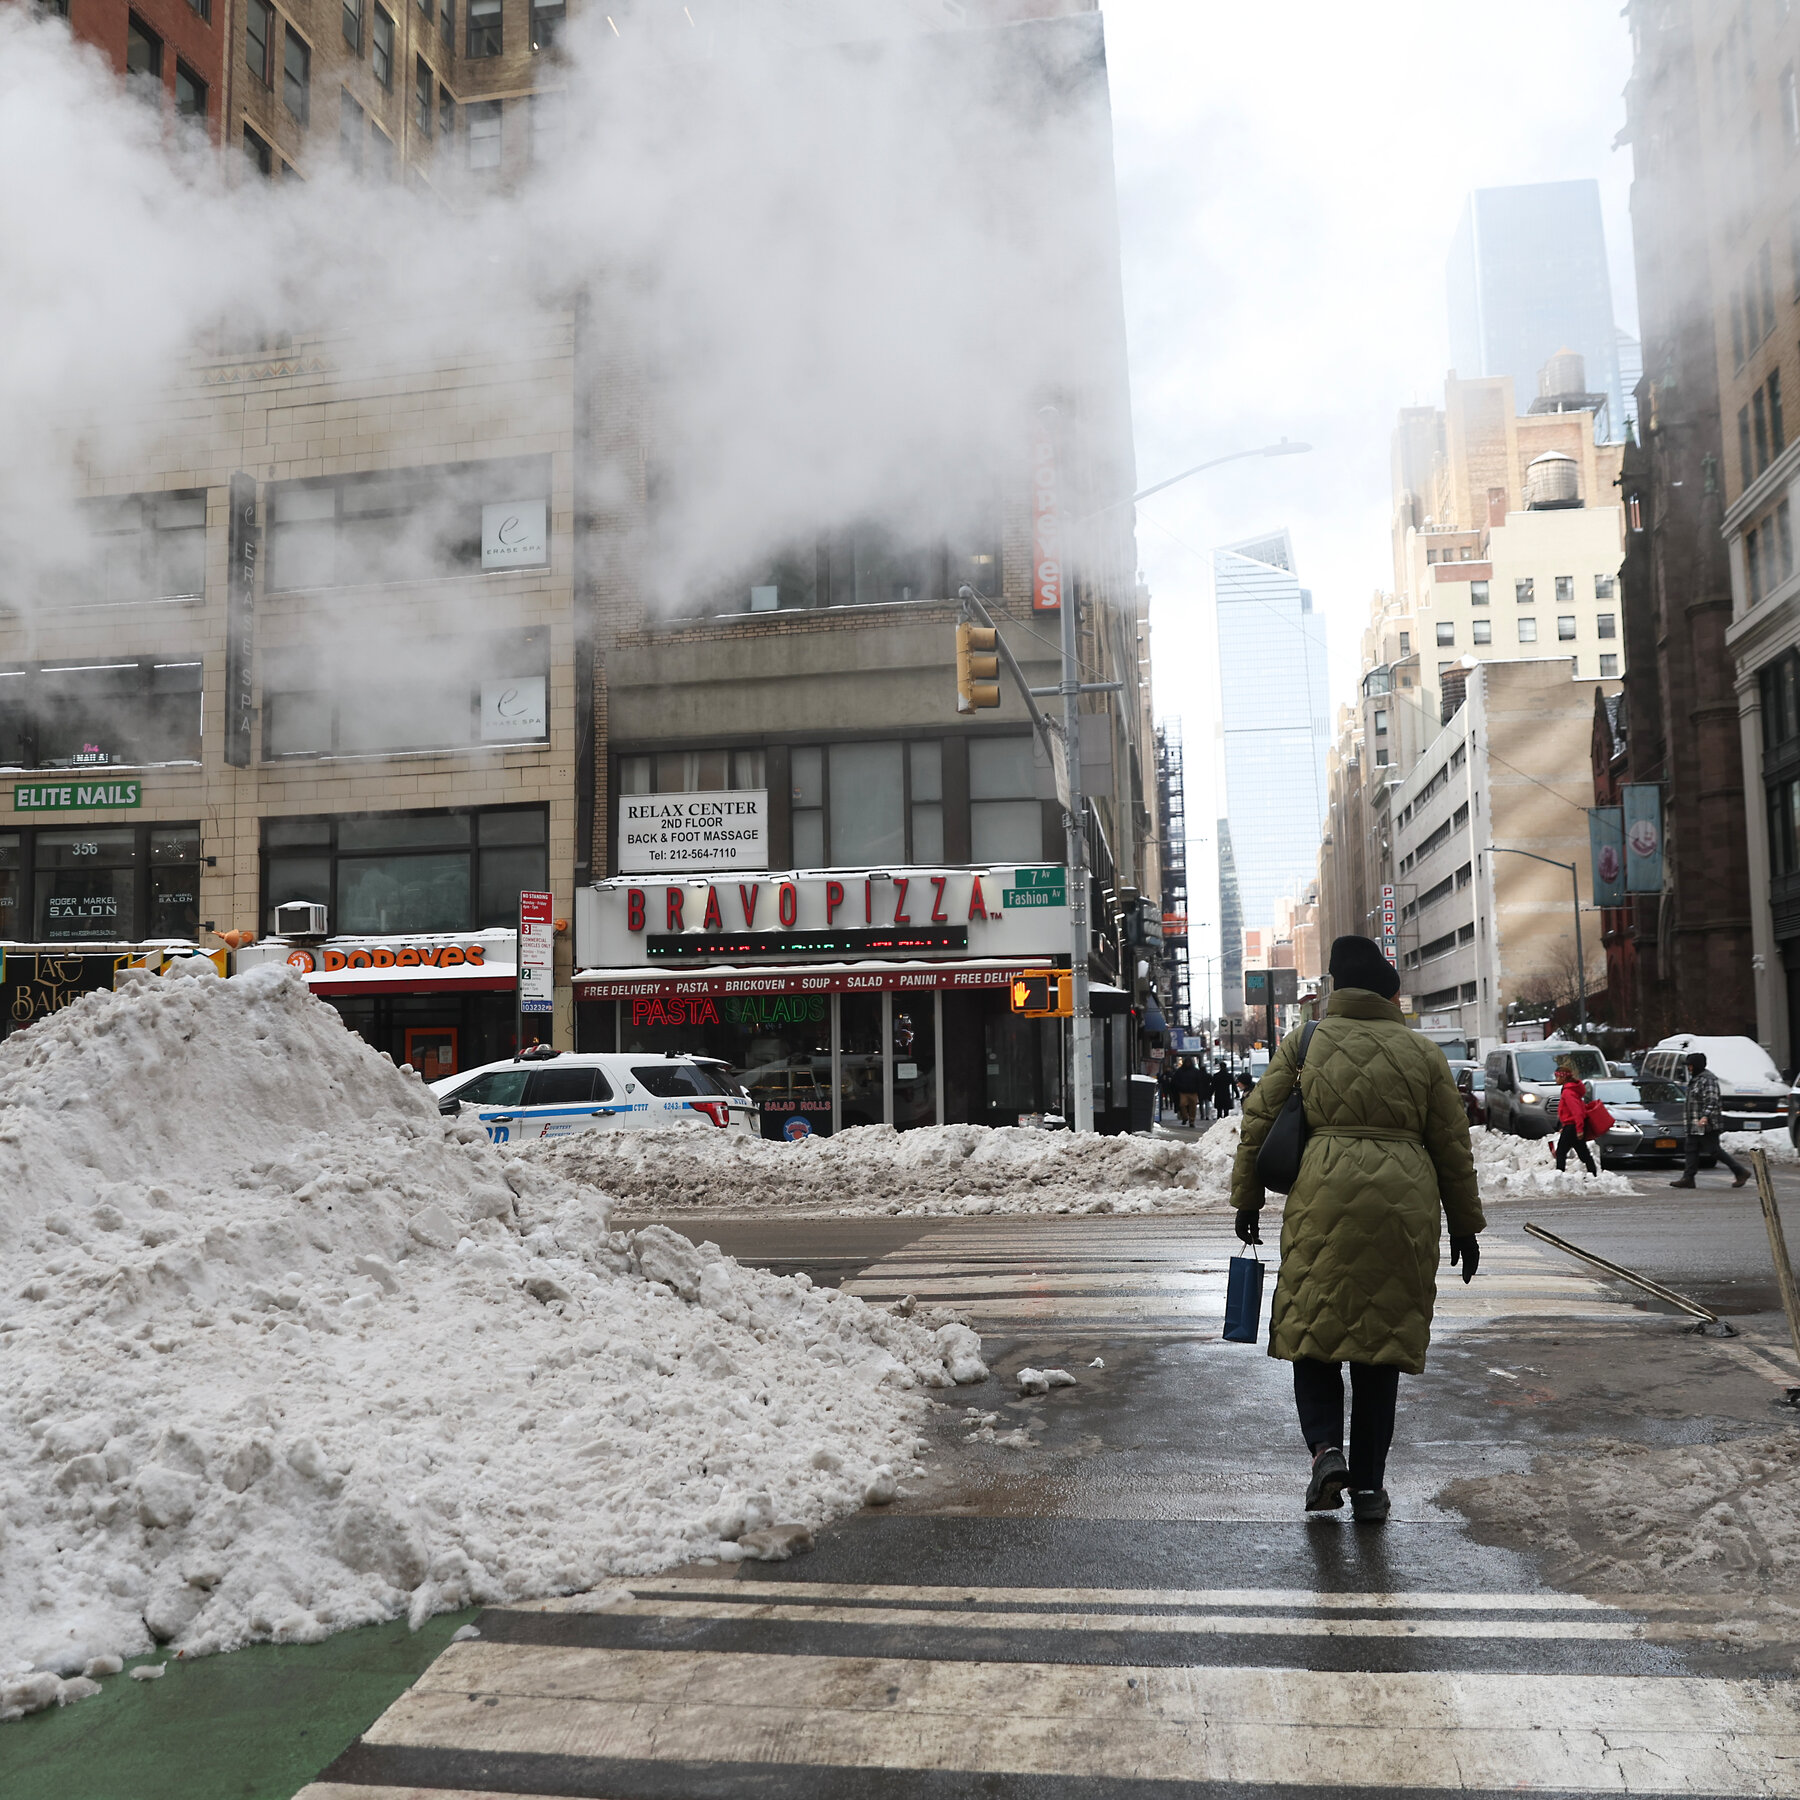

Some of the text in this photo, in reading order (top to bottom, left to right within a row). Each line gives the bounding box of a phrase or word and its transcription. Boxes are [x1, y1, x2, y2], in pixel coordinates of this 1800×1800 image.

[486, 544, 542, 555] ERASE SPA
[240, 669, 253, 735] SPA
[522, 717, 542, 725] SPA
[17, 784, 137, 807] ELITE NAILS
[627, 801, 758, 819] RELAX CENTER
[661, 817, 723, 829] 2ND FLOOR
[627, 829, 759, 844] BACK & FOOT MASSAGE
[72, 842, 98, 856] 356
[649, 847, 737, 860] Tel: 212-564-7110
[1031, 870, 1050, 885] 7 Av
[50, 897, 117, 906] ROGER MARKEL
[627, 882, 798, 931] BRAVO
[826, 874, 988, 925] PIZZA
[1009, 889, 1061, 905] Fashion Av
[50, 905, 118, 916] SALON
[1384, 887, 1394, 935] PARK
[524, 924, 530, 934] 3
[523, 969, 530, 979] 2
[583, 985, 610, 997] FREE
[611, 983, 661, 996] DELIVERY
[676, 981, 709, 993] PASTA
[725, 978, 786, 992] BRICKOVEN
[801, 977, 830, 989] SOUP
[847, 975, 883, 988] SALAD
[900, 974, 938, 986] PANINI
[954, 972, 982, 984] FREE
[11, 985, 91, 1022] BAKE
[522, 1003, 546, 1011] 103232
[632, 994, 825, 1026] PASTA SALADS
[764, 1100, 832, 1111] SALAD ROLLS
